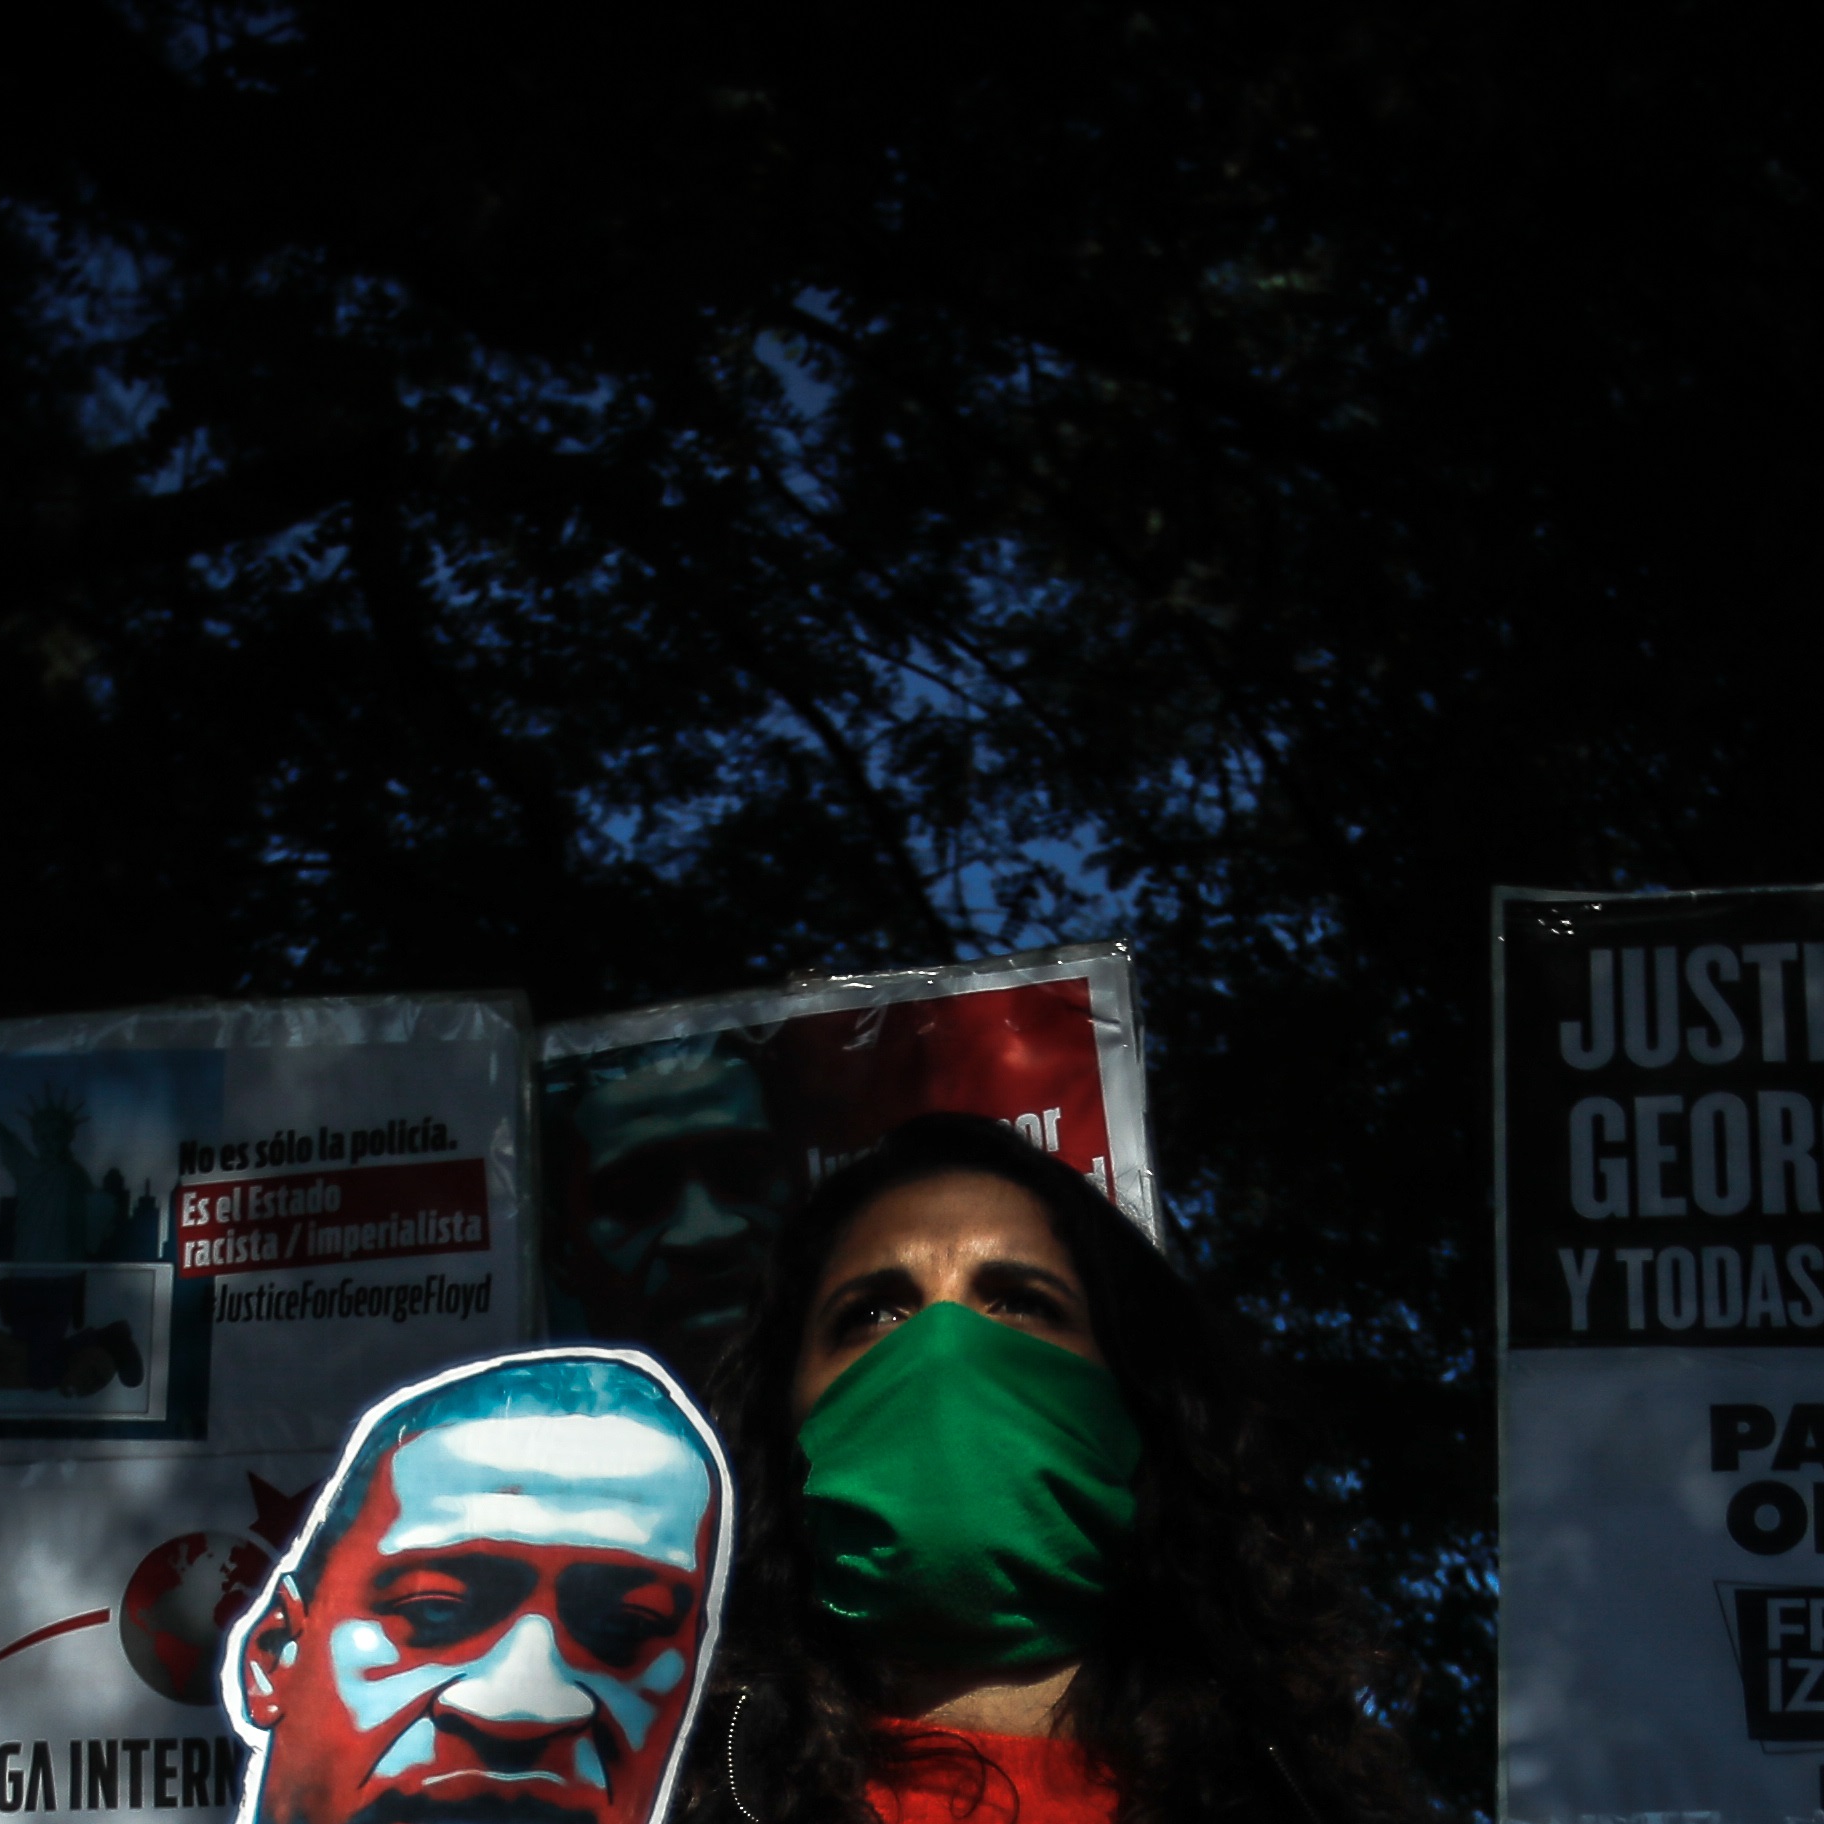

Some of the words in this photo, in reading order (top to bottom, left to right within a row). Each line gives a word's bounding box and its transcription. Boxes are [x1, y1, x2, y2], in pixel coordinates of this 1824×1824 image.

[179, 1140, 213, 1175] No
[219, 1142, 248, 1171] es
[255, 1129, 312, 1168] sólo
[319, 1127, 345, 1160] la
[350, 1116, 458, 1164] policía.
[181, 1191, 211, 1228] Es
[215, 1186, 241, 1222] el
[246, 1177, 342, 1222] Estado
[182, 1228, 280, 1270] racista
[306, 1210, 483, 1260] imperialista
[1557, 1247, 1602, 1333] Y
